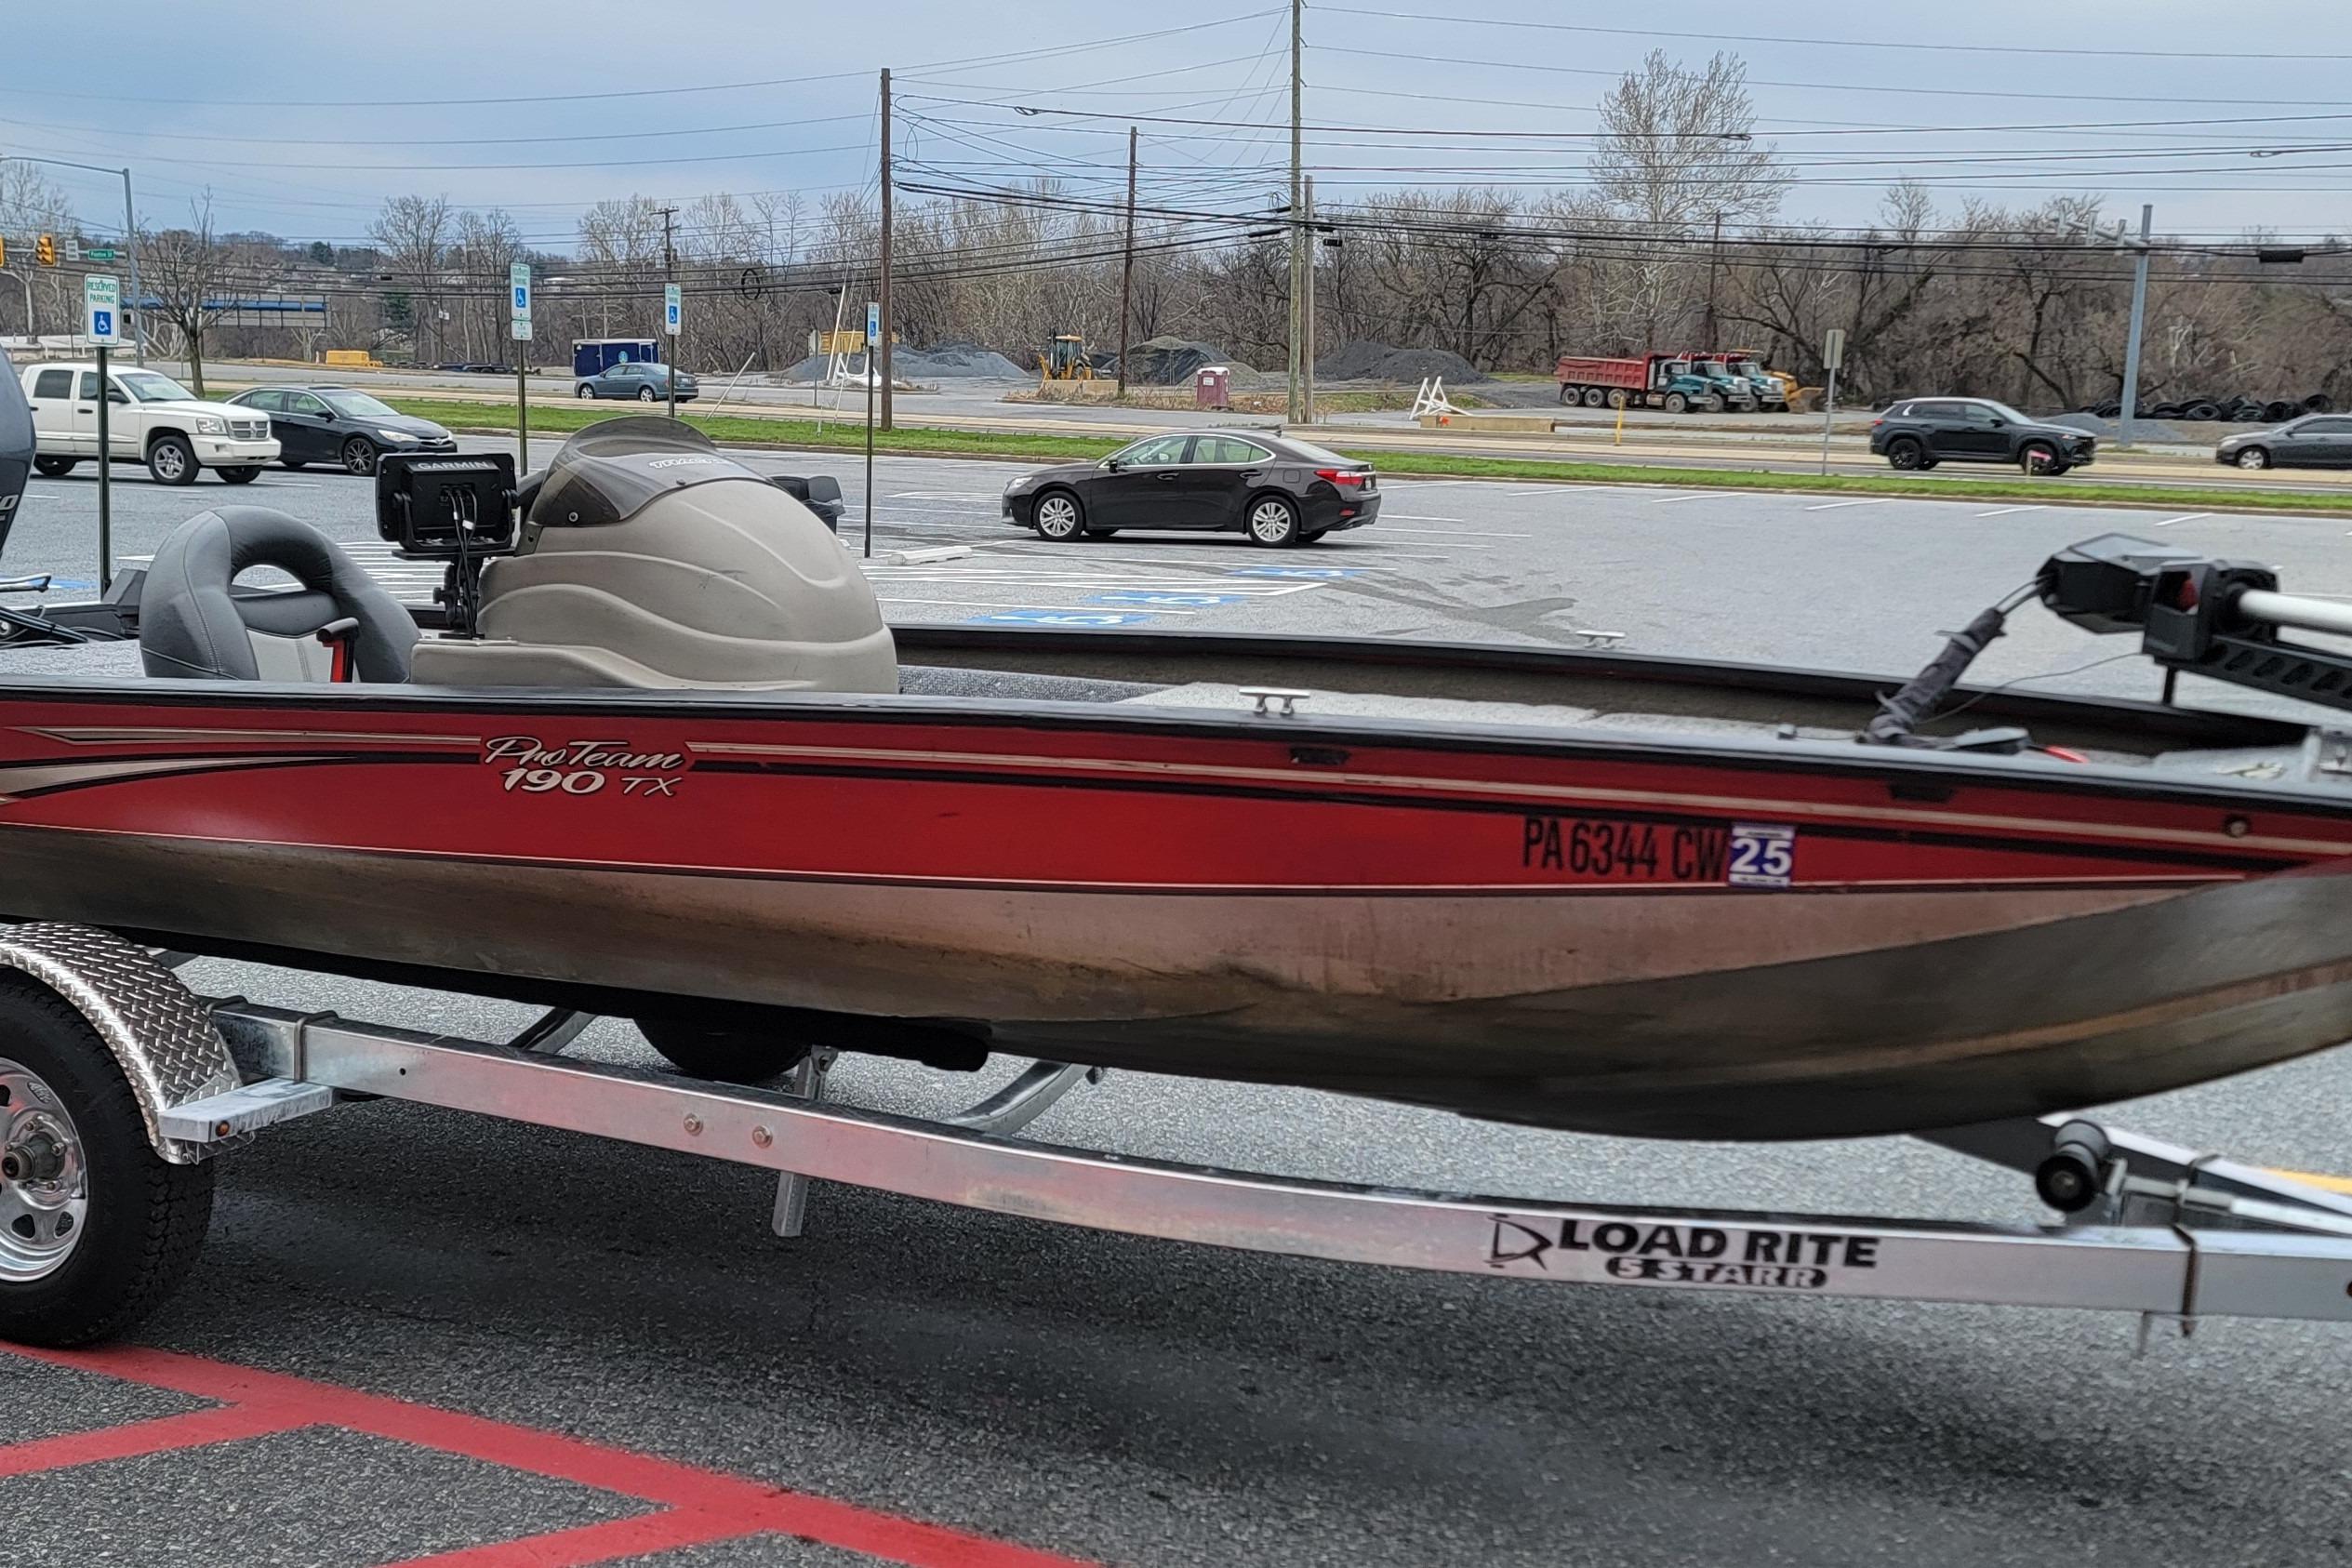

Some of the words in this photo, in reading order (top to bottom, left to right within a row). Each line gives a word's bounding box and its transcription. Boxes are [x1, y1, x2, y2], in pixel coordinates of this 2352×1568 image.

[87, 282, 116, 293] RESERVED
[89, 294, 115, 305] PARKING
[418, 461, 490, 471] GARMIN
[501, 768, 606, 794] 190
[620, 776, 684, 797] TX
[1671, 827, 1727, 883] CW
[1730, 838, 1793, 875] 25
[1557, 1218, 1727, 1258] LOAD
[1744, 1230, 1880, 1269] RITE
[1656, 1260, 1818, 1289] STARR
